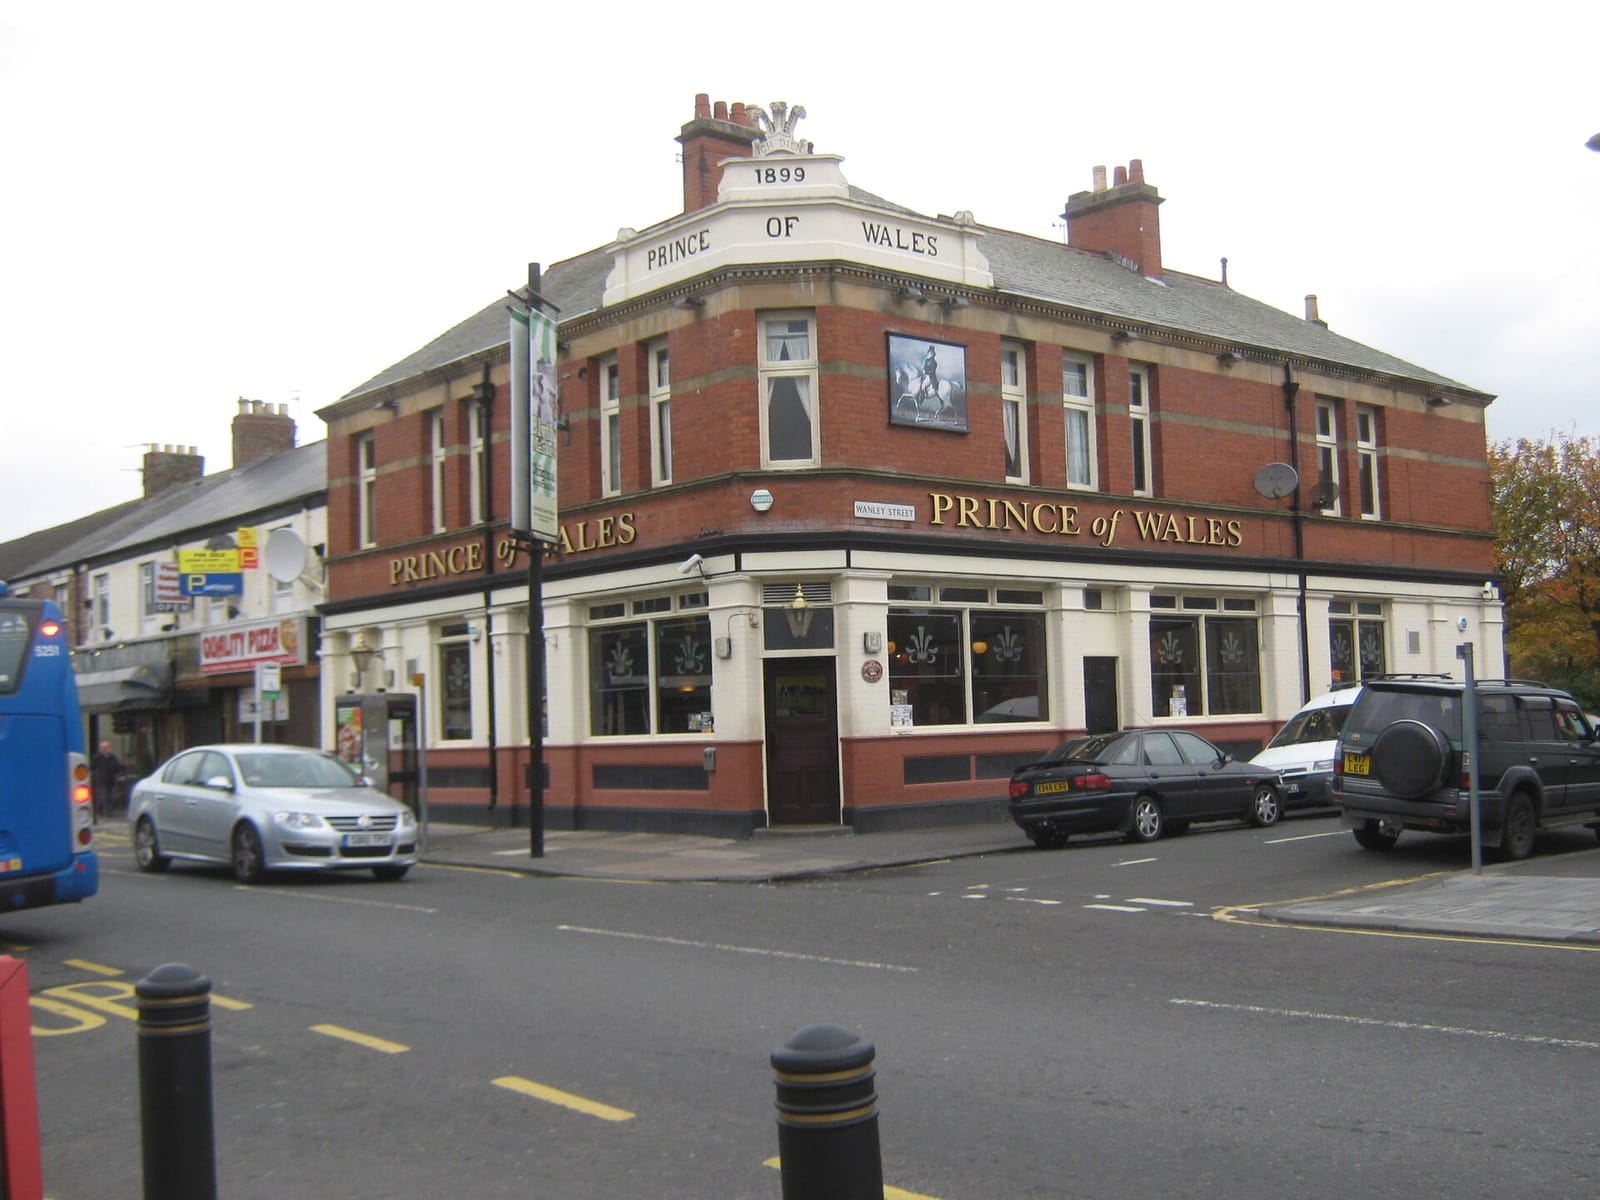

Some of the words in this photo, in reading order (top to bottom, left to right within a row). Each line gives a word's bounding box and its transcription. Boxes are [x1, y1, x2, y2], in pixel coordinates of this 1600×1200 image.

[755, 167, 805, 184] 1899
[648, 229, 710, 271] PRINCE
[766, 216, 800, 237] OF
[862, 222, 938, 257] WALES
[856, 504, 885, 516] WANLEY
[888, 507, 914, 518] STREET
[930, 493, 1081, 535] PRINCE
[1092, 509, 1123, 547] of
[1133, 511, 1243, 547] WALES
[389, 542, 483, 586] PRINCE
[545, 512, 637, 558] ALES
[157, 603, 189, 612] OPEN
[35, 645, 60, 657] 5251
[203, 631, 245, 660] QUALITY
[248, 626, 280, 654] PIZZA
[1348, 763, 1365, 773] LEG
